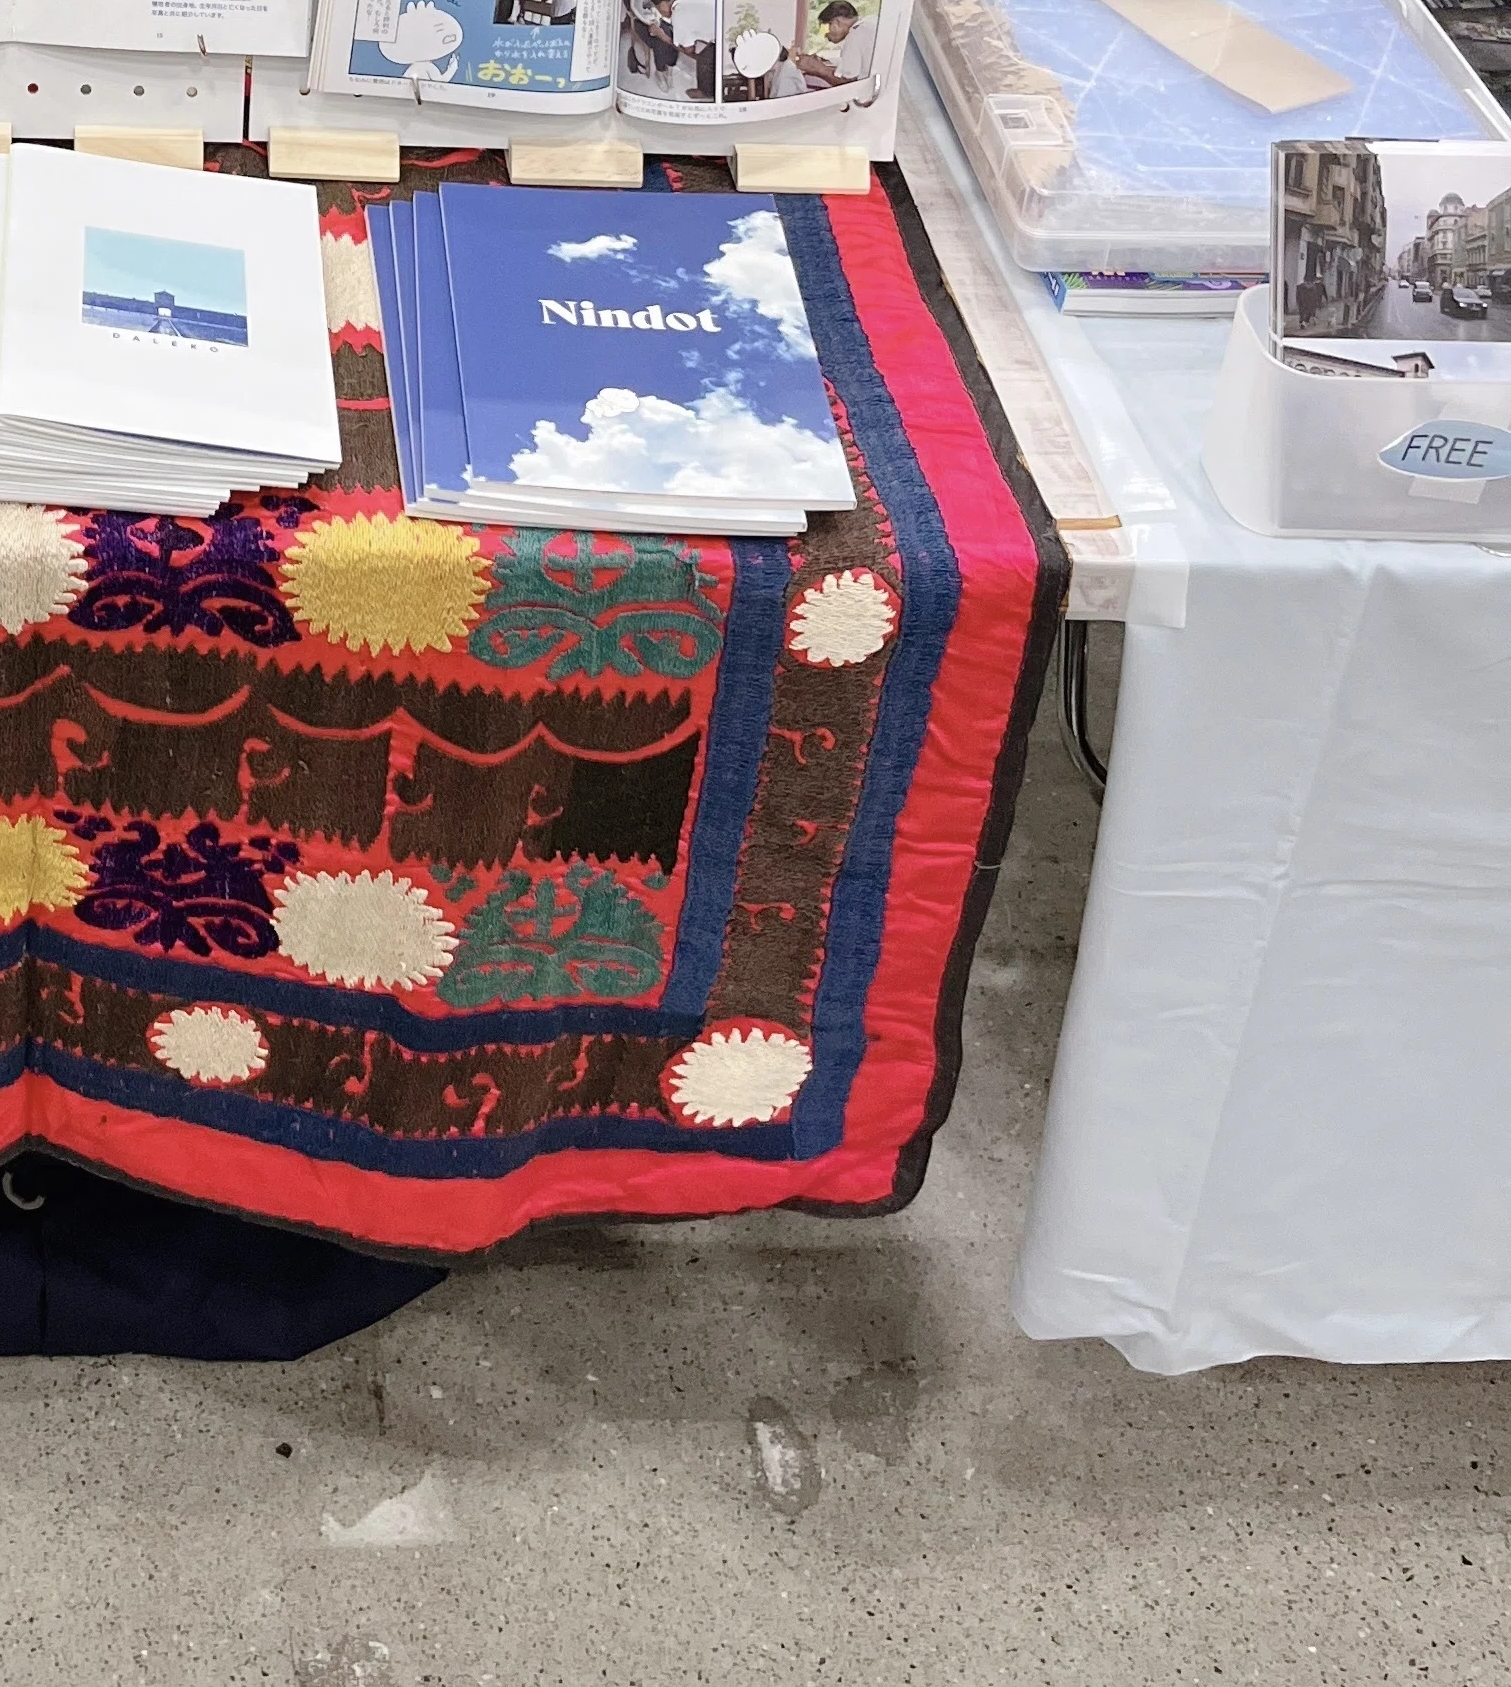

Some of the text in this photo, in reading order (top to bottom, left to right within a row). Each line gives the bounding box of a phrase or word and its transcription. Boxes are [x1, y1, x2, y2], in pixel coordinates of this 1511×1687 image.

[540, 298, 722, 334] Nindot
[111, 330, 219, 355] DALEKO
[1400, 432, 1493, 469] FREE
